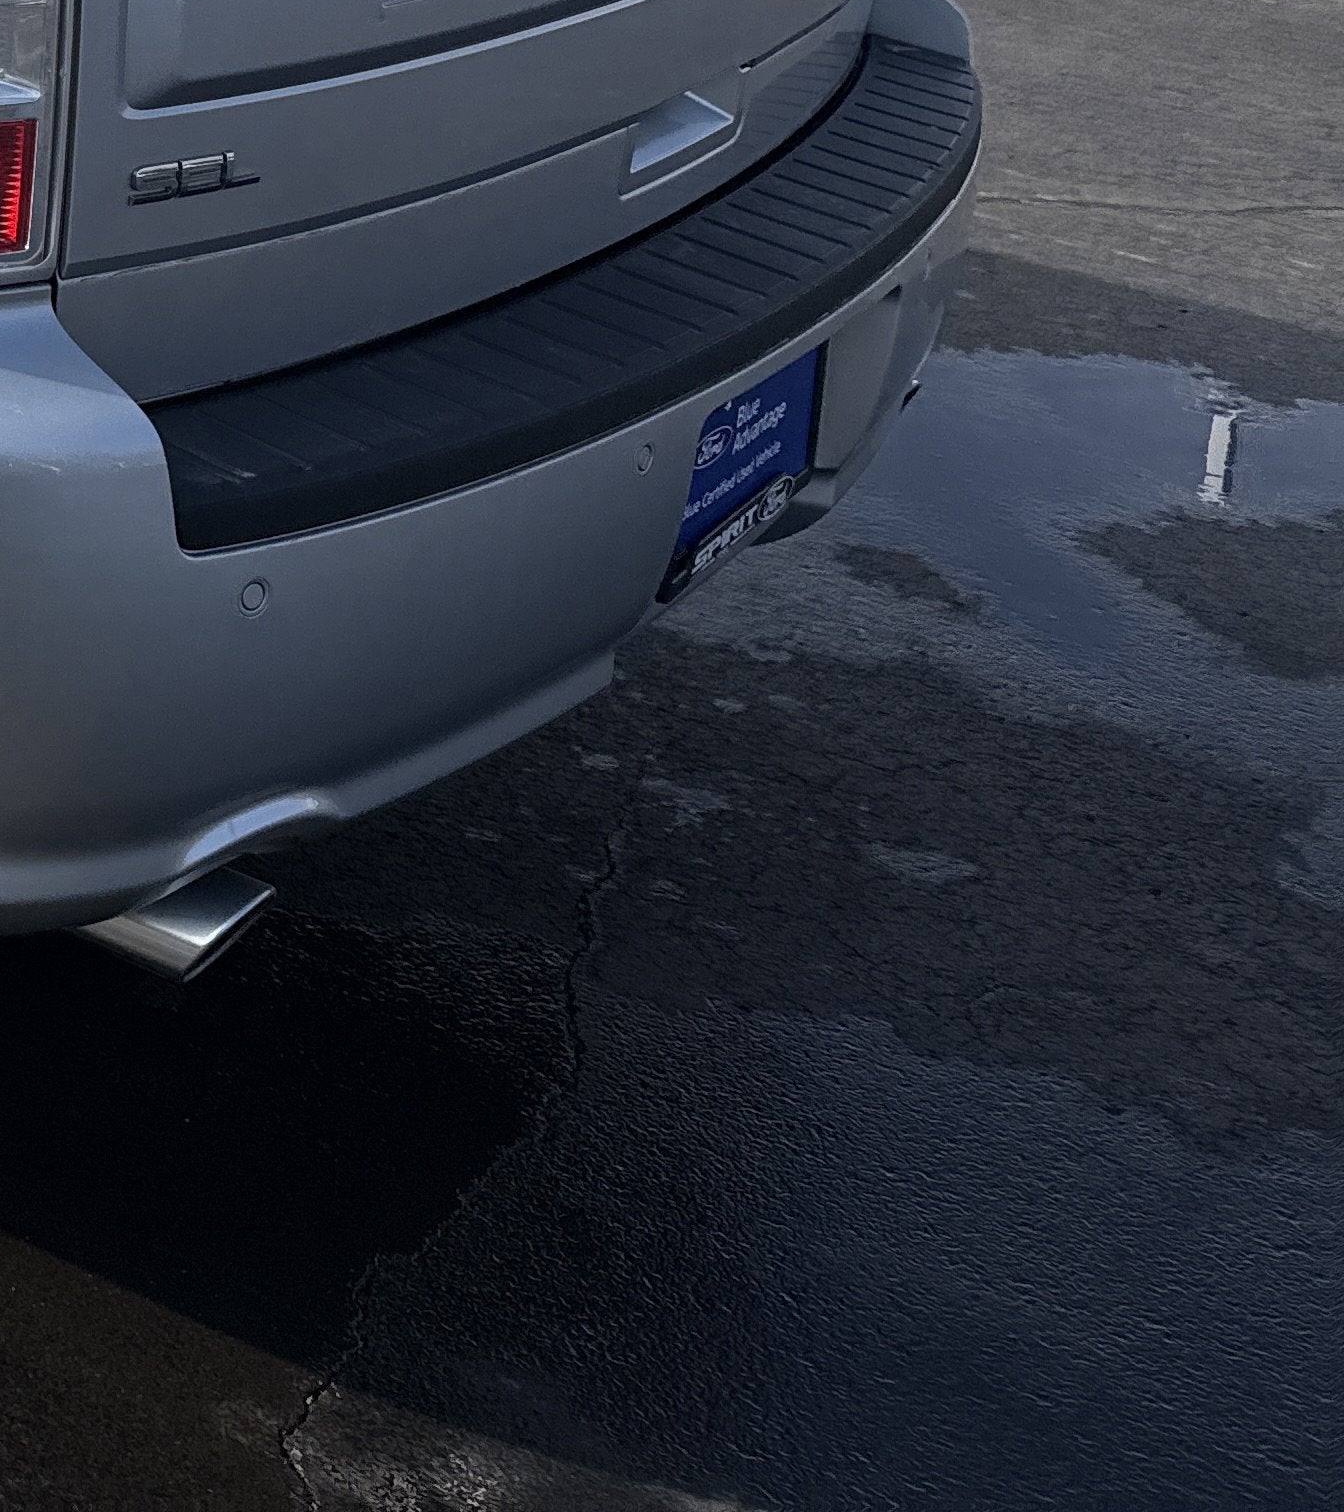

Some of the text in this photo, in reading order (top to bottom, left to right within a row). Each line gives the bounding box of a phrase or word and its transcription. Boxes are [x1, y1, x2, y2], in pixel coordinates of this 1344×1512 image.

[127, 150, 261, 206] SEL
[732, 401, 787, 455] Advantage
[736, 398, 761, 428] Blue
[692, 503, 759, 575] SPIRIT
